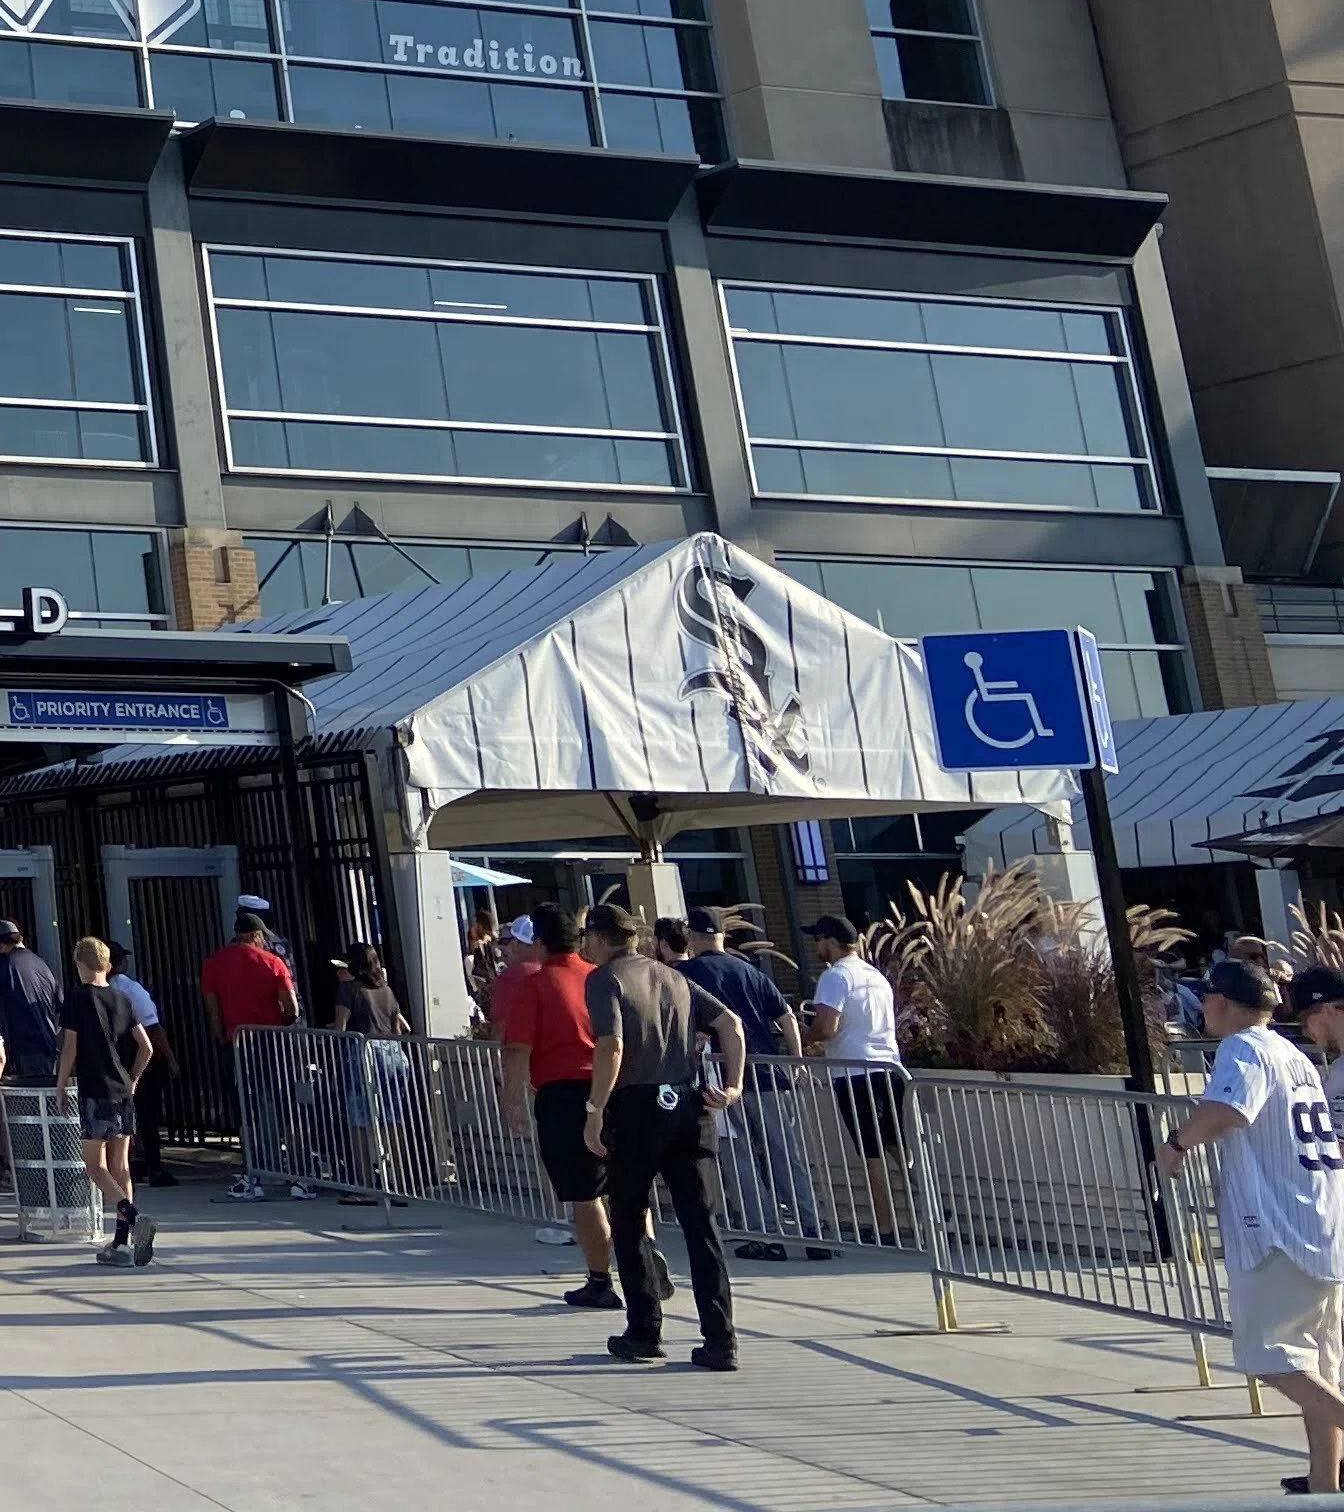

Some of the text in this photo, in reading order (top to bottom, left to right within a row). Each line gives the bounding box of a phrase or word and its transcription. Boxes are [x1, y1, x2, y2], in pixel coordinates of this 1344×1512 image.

[389, 34, 584, 78] Tradition
[36, 700, 201, 720] PRIORITY ENTRANCE
